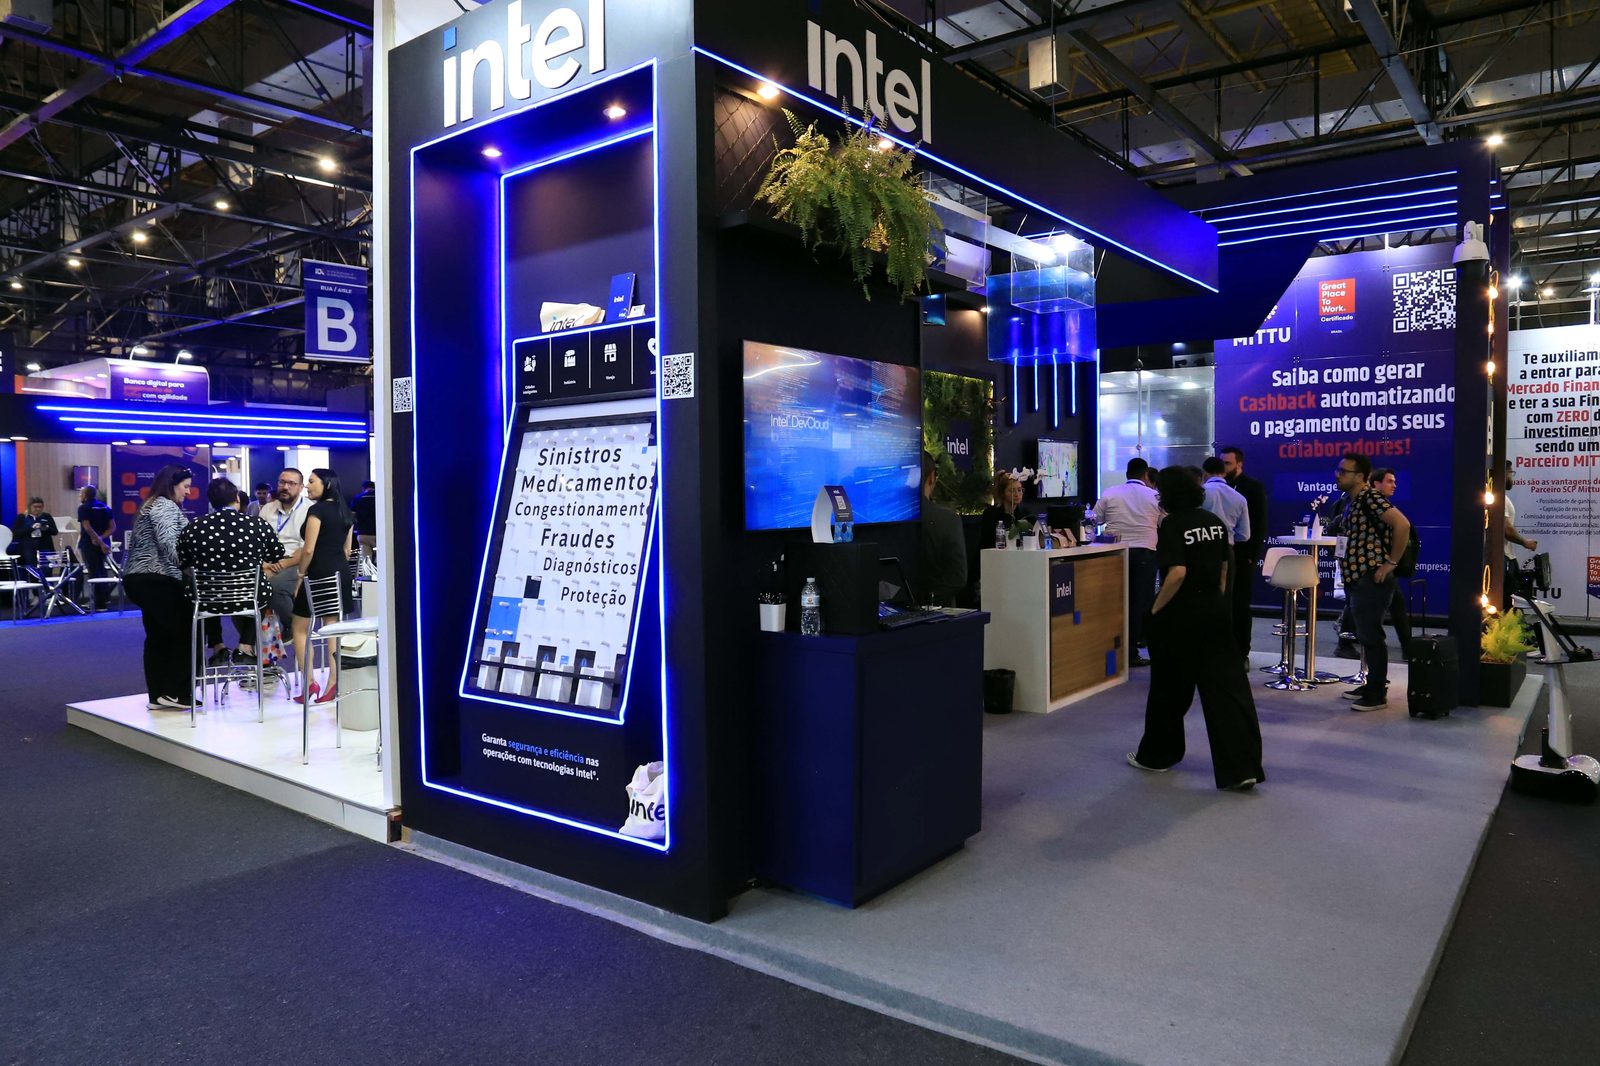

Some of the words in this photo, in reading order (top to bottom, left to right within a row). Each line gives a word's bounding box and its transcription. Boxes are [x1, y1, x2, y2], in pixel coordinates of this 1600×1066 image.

[443, 0, 606, 128] intel
[1321, 282, 1346, 291] Great
[1322, 290, 1346, 298] Place
[1322, 304, 1346, 313] Work.
[317, 296, 357, 352] B
[1523, 353, 1538, 365] Te
[1541, 349, 1600, 364] auxiliam
[1272, 367, 1319, 387] Saiba
[1323, 366, 1370, 384] como
[1374, 362, 1425, 385] gerar
[1520, 369, 1527, 380] a
[1531, 367, 1572, 379] entrar
[123, 377, 146, 385] Banco
[146, 380, 168, 388] digital
[1506, 381, 1559, 395] Mercado
[1239, 391, 1317, 413] Cashback
[1320, 384, 1455, 409] automatizando
[1508, 399, 1516, 410] e
[1519, 398, 1538, 409] ter
[1541, 398, 1549, 408] a
[1552, 397, 1575, 408] sua
[791, 415, 830, 430] DevCloud
[1526, 413, 1553, 424] com
[1556, 410, 1590, 423] ZERO
[1250, 421, 1260, 436] o
[1264, 416, 1361, 439] pagamento
[1365, 413, 1397, 432] dos
[1402, 413, 1445, 431] seus
[946, 436, 969, 456] intel
[1279, 438, 1411, 459] colaboradores!
[1535, 440, 1575, 453] sendo
[1578, 441, 1600, 452] um
[537, 447, 622, 467] Sinistros
[1516, 455, 1570, 468] Parceiro
[1297, 481, 1341, 494] Vantage
[1512, 478, 1526, 486] uais
[1527, 477, 1540, 486] são
[1551, 478, 1592, 488] vantagens
[1562, 485, 1577, 493] SCP
[1578, 485, 1600, 493] Mittu
[540, 528, 616, 549] Fraudes
[1184, 525, 1225, 546] STAFF
[543, 556, 637, 576] Diagnósticos
[1415, 562, 1451, 573] empresa;
[560, 586, 627, 608] Proteção
[1056, 581, 1072, 598] intel
[481, 733, 508, 747] Garanta
[508, 740, 543, 756] segurança
[543, 748, 549, 756] e
[549, 748, 585, 764] eficiência
[585, 757, 600, 767] nas
[482, 748, 516, 763] operações
[517, 756, 532, 766] com
[533, 758, 575, 776] tecnologias
